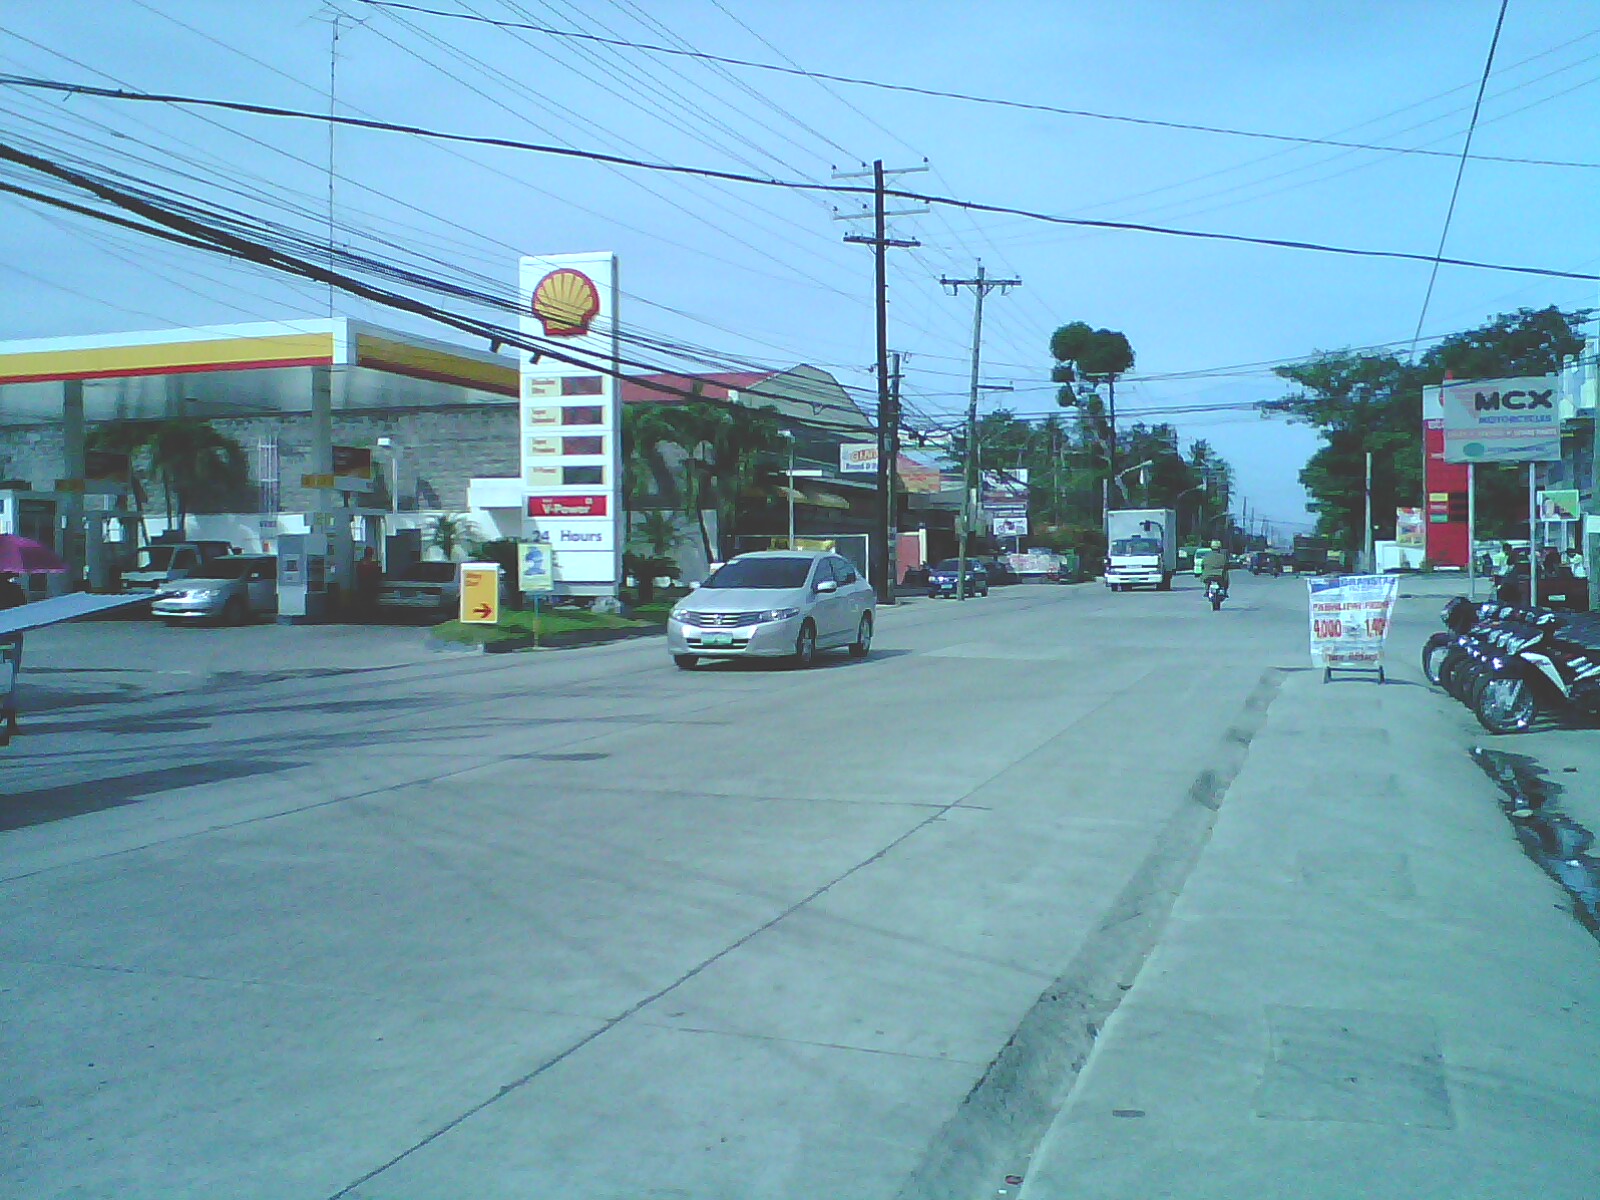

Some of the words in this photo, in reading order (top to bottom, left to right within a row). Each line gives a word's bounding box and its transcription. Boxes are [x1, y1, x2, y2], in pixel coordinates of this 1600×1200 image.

[1474, 389, 1553, 411] MCX
[541, 503, 591, 514] V-Power
[532, 529, 550, 542] 24
[560, 530, 603, 542] Hours
